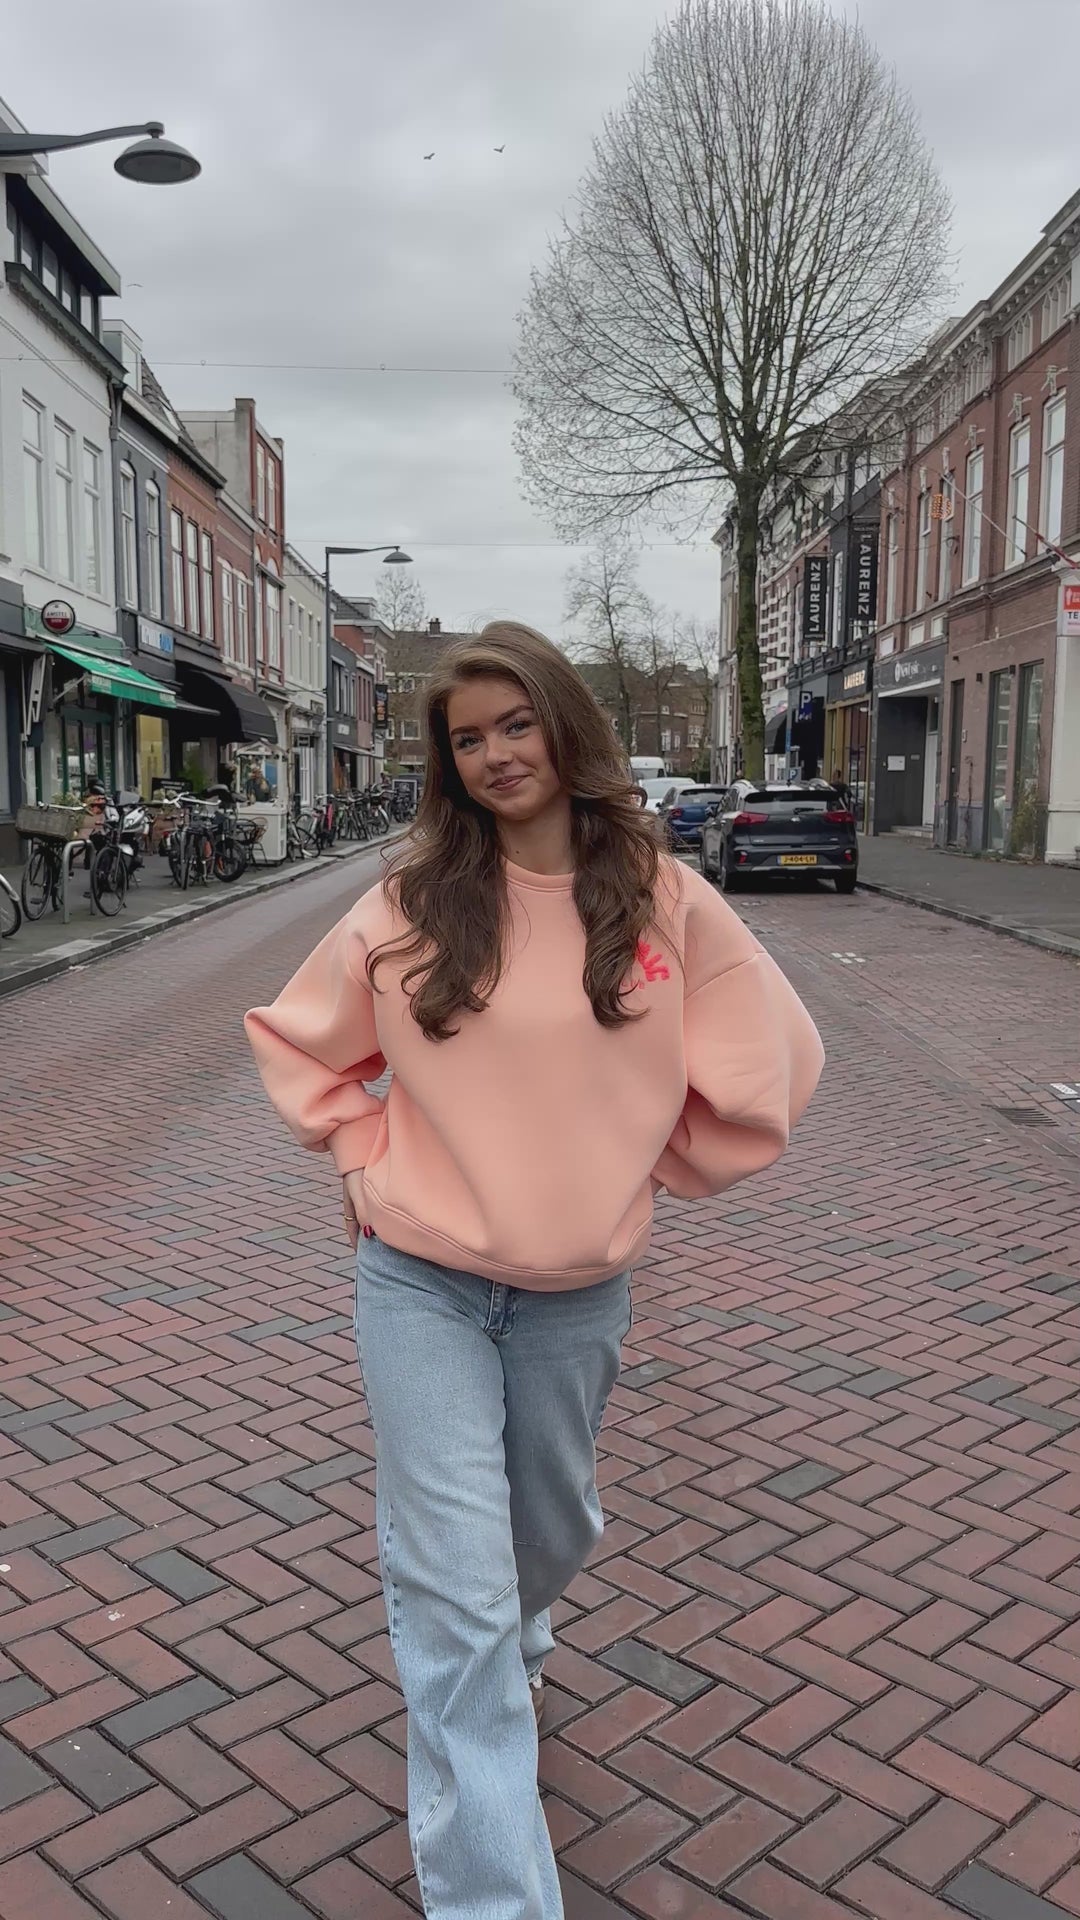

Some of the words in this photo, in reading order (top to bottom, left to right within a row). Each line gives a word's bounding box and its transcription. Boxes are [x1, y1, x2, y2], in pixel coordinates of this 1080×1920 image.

[858, 533, 872, 615] LAURENZ
[810, 561, 821, 632] LAURENZ
[801, 692, 811, 709] P
[790, 770, 796, 779] P
